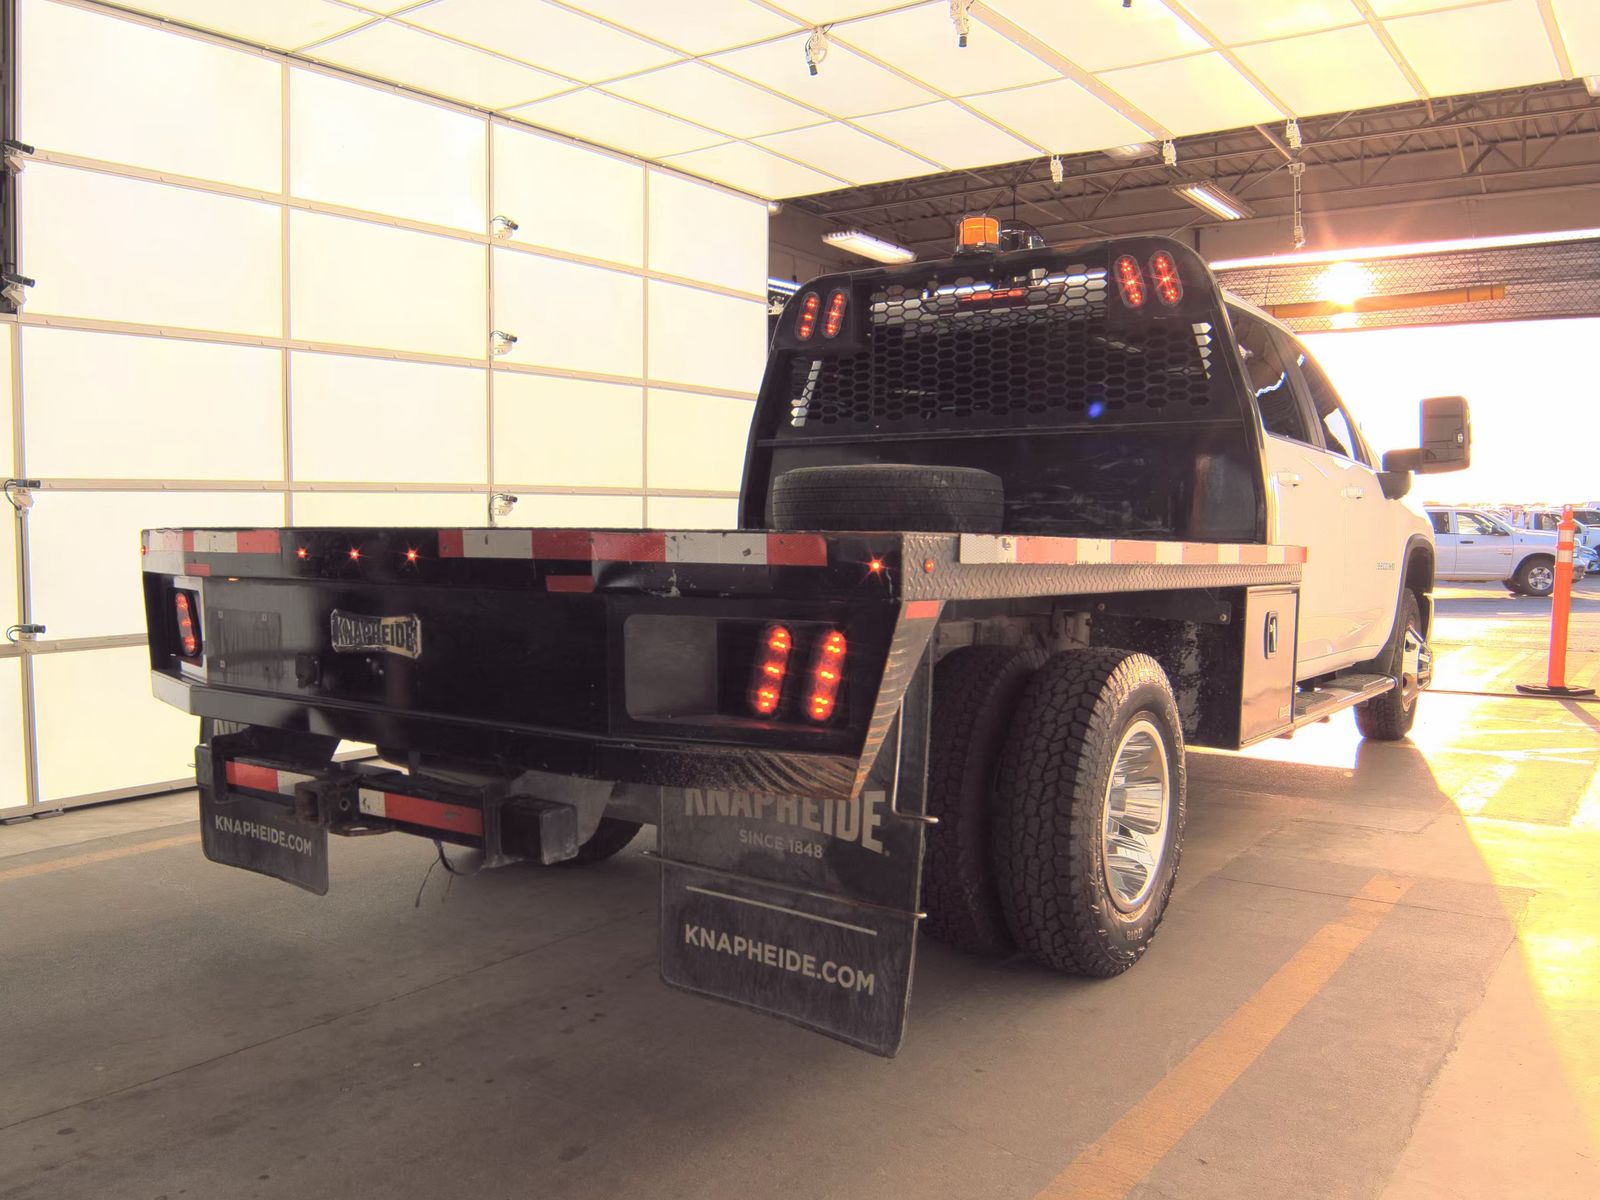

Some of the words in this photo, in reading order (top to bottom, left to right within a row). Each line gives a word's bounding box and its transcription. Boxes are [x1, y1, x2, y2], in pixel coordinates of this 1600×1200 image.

[334, 614, 418, 655] KNAPHEIDE
[214, 814, 313, 857] KNAPHEIDE.COM
[738, 829, 785, 851] SINCE
[789, 839, 824, 859] 1848
[684, 923, 876, 997] KNAPHEIDE.COM
